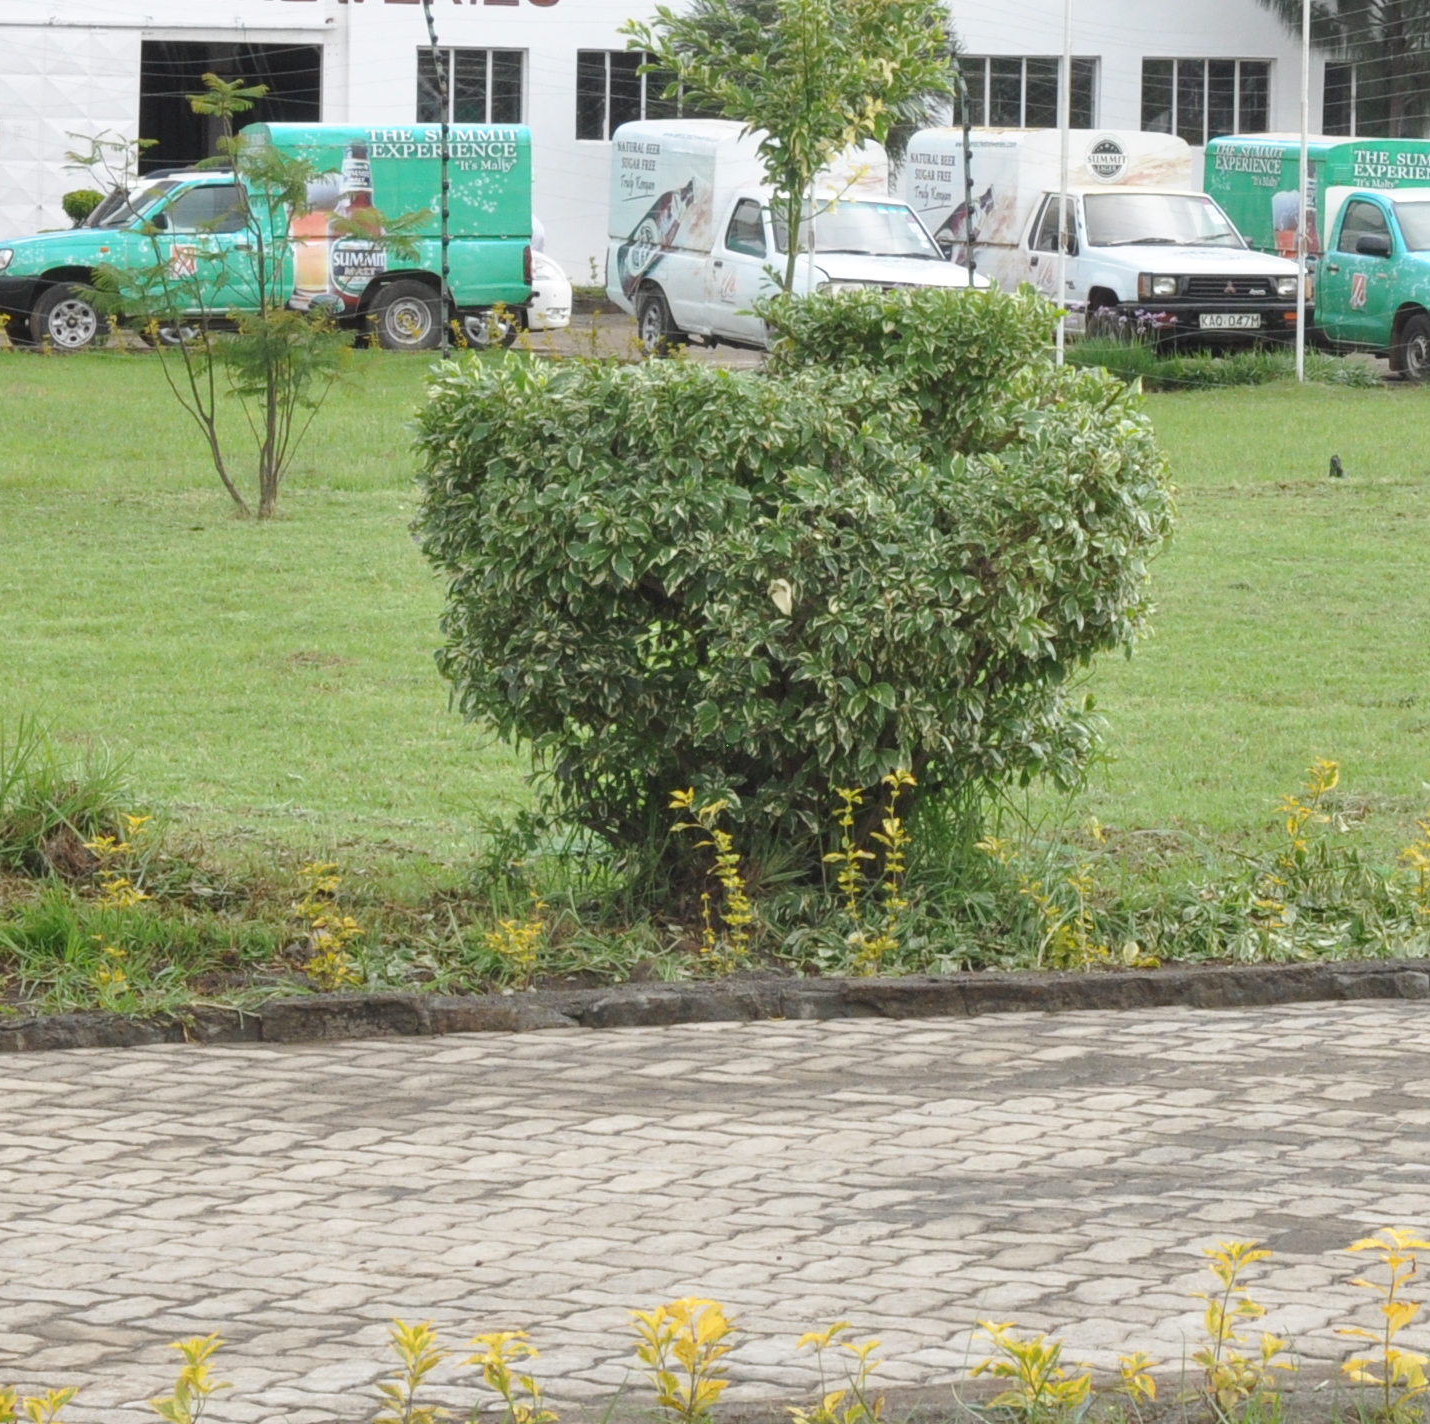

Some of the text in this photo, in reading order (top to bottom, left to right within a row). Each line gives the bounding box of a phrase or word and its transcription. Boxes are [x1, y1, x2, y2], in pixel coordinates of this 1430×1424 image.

[365, 129, 520, 143] THE SUMMIT
[370, 143, 518, 159] EXPERIENCE
[1214, 144, 1287, 158] THE SUMMIT
[1354, 150, 1390, 165] THE
[1087, 155, 1127, 164] SUMMIT
[1214, 155, 1282, 174] EXPERIENCE
